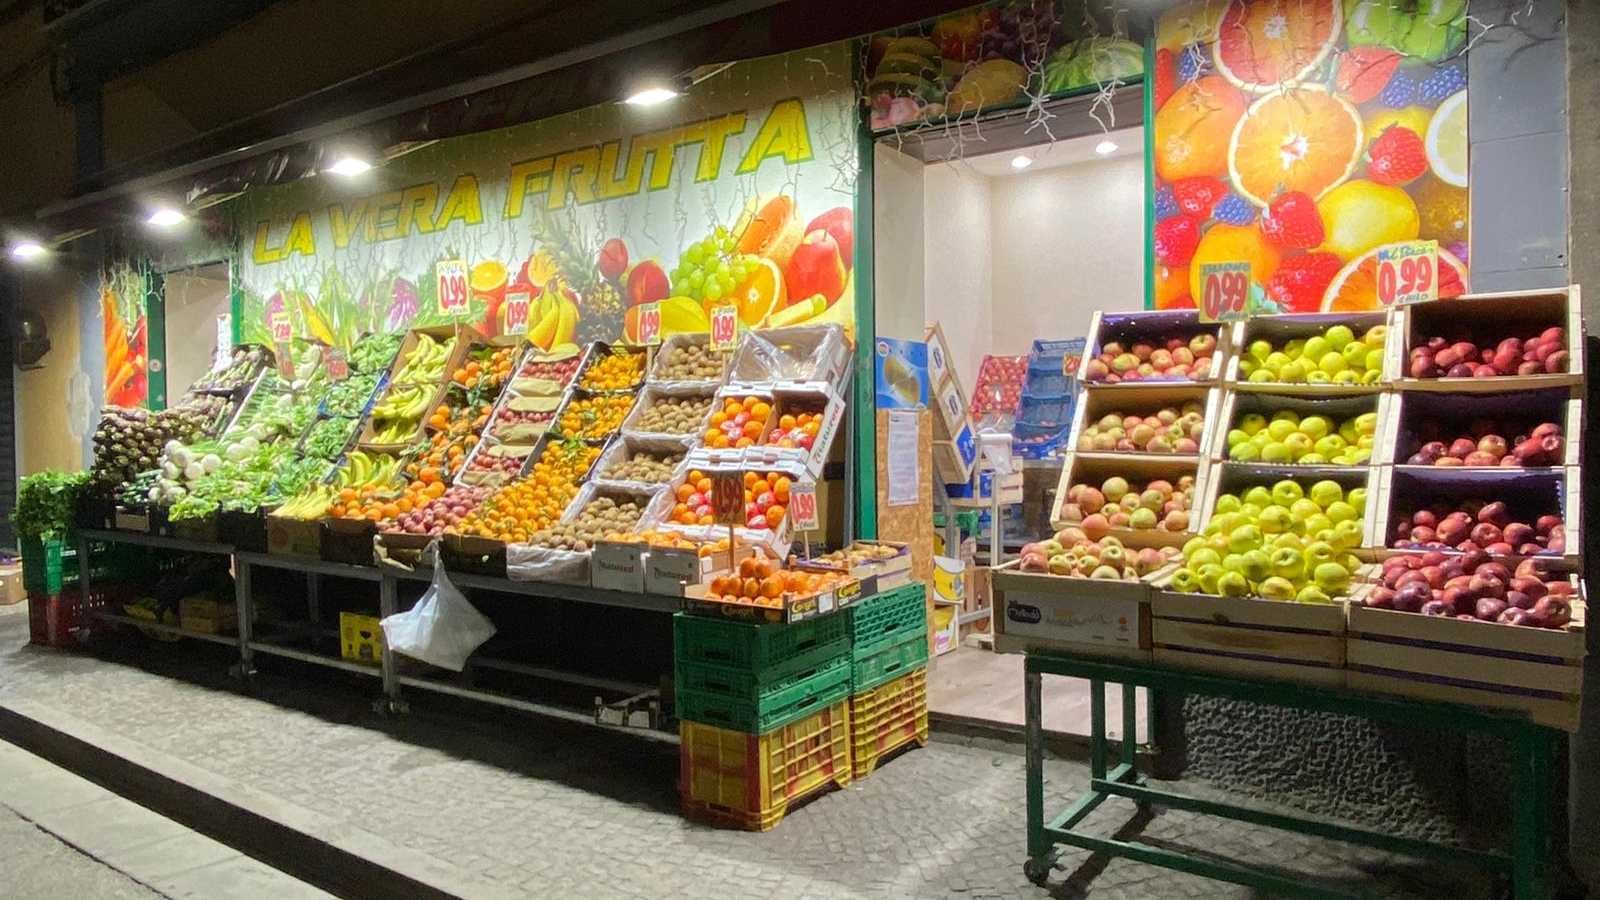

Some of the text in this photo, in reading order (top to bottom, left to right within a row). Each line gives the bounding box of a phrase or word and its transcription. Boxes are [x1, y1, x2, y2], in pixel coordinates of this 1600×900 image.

[253, 96, 816, 266] LA VERA FRUTTA
